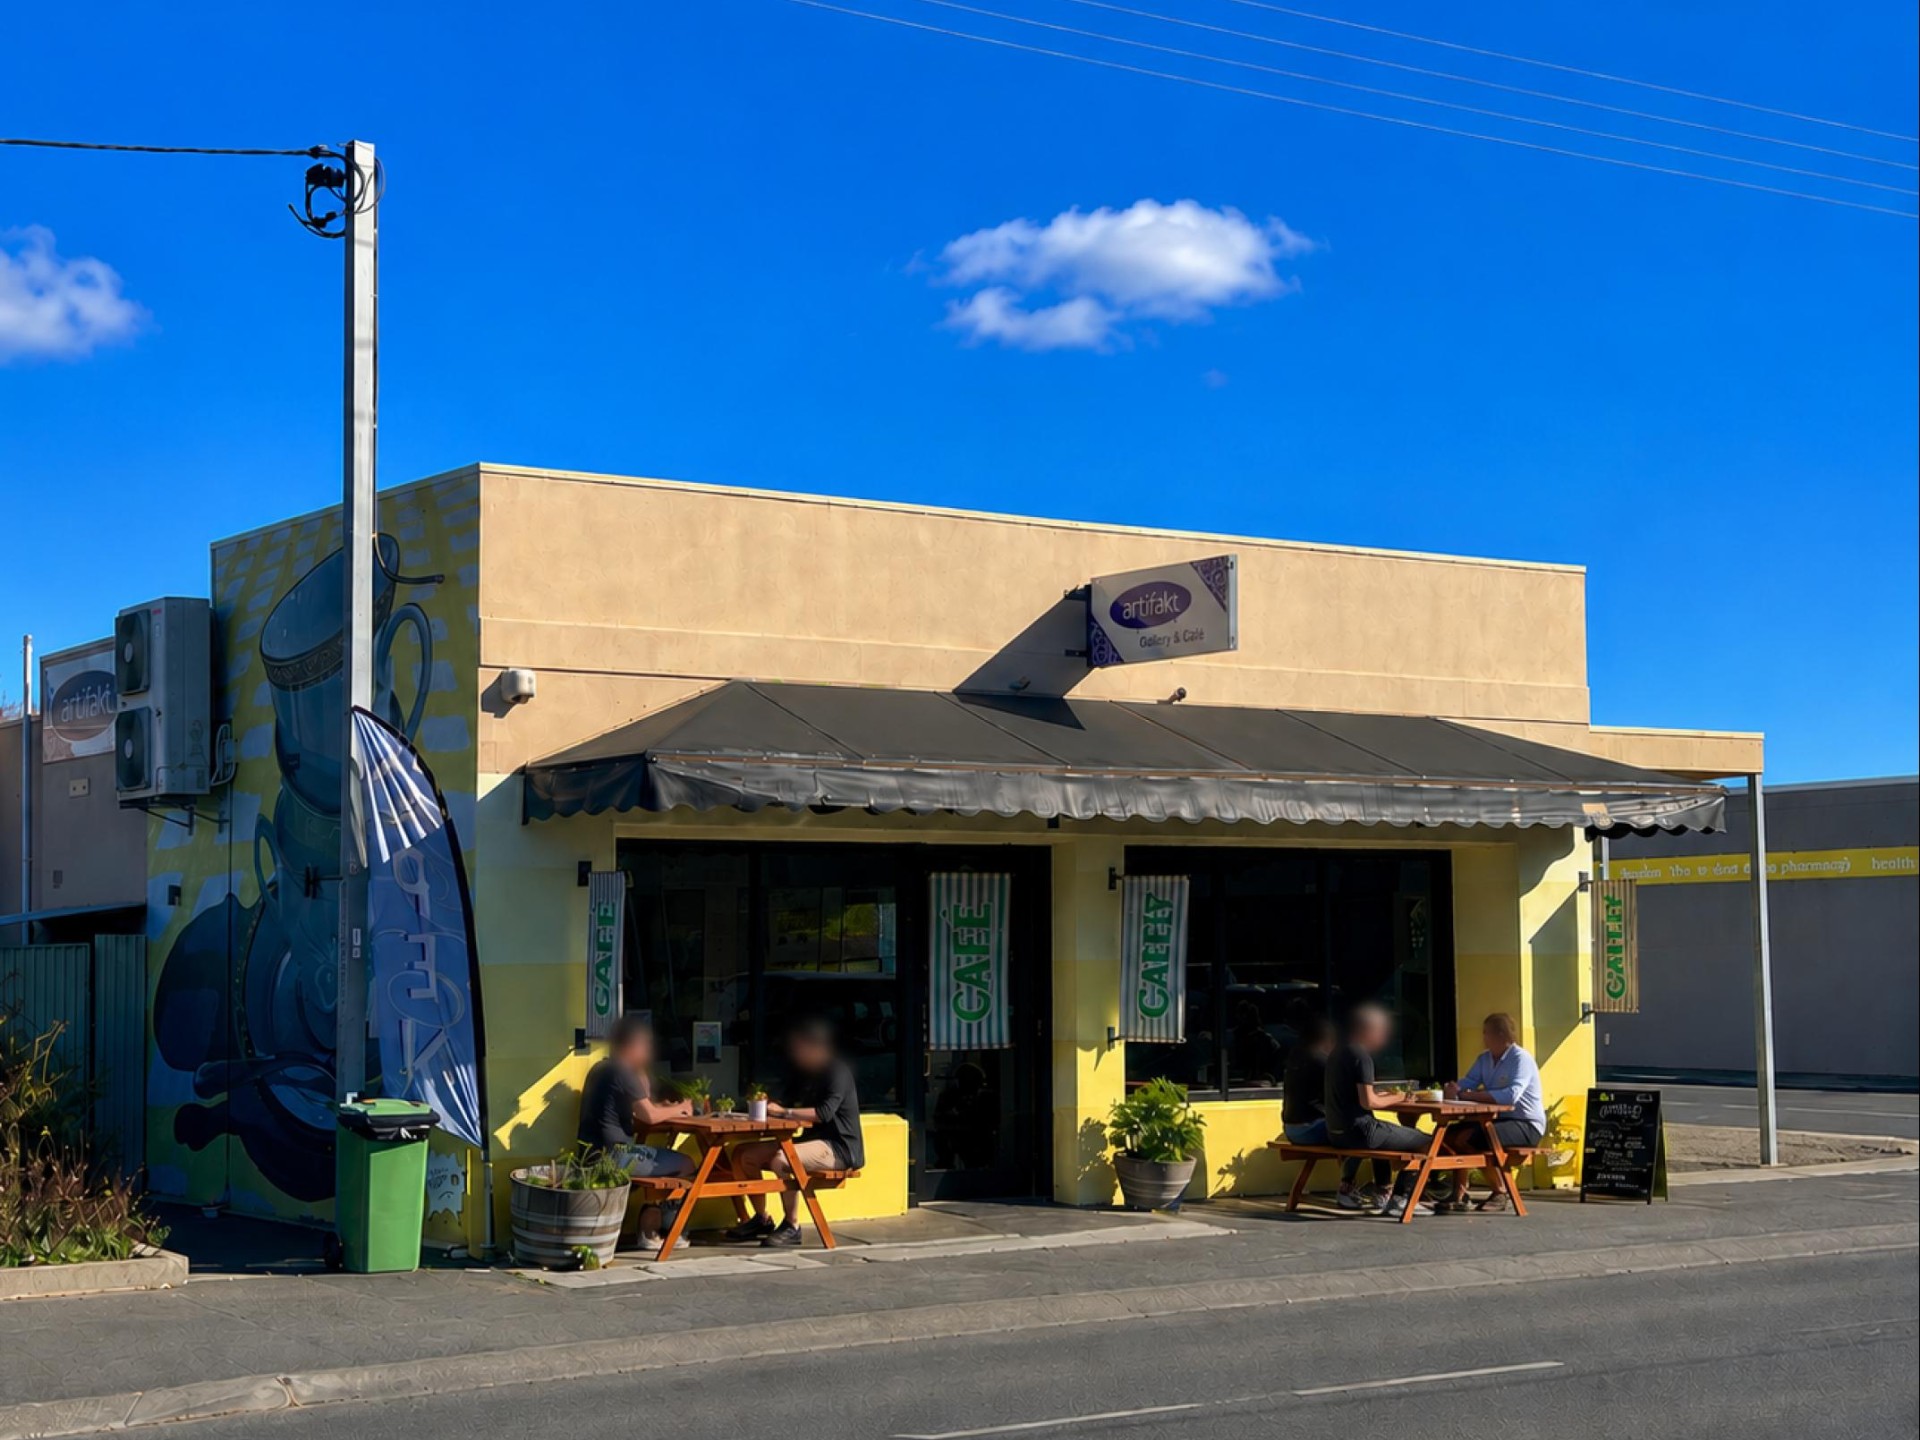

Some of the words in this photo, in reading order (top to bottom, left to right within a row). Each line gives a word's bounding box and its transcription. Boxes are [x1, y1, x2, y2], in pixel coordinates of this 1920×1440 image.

[1122, 590, 1180, 620] artifakt
[1173, 631, 1181, 644] &
[62, 683, 115, 723] artifakt
[1871, 856, 1915, 871] health
